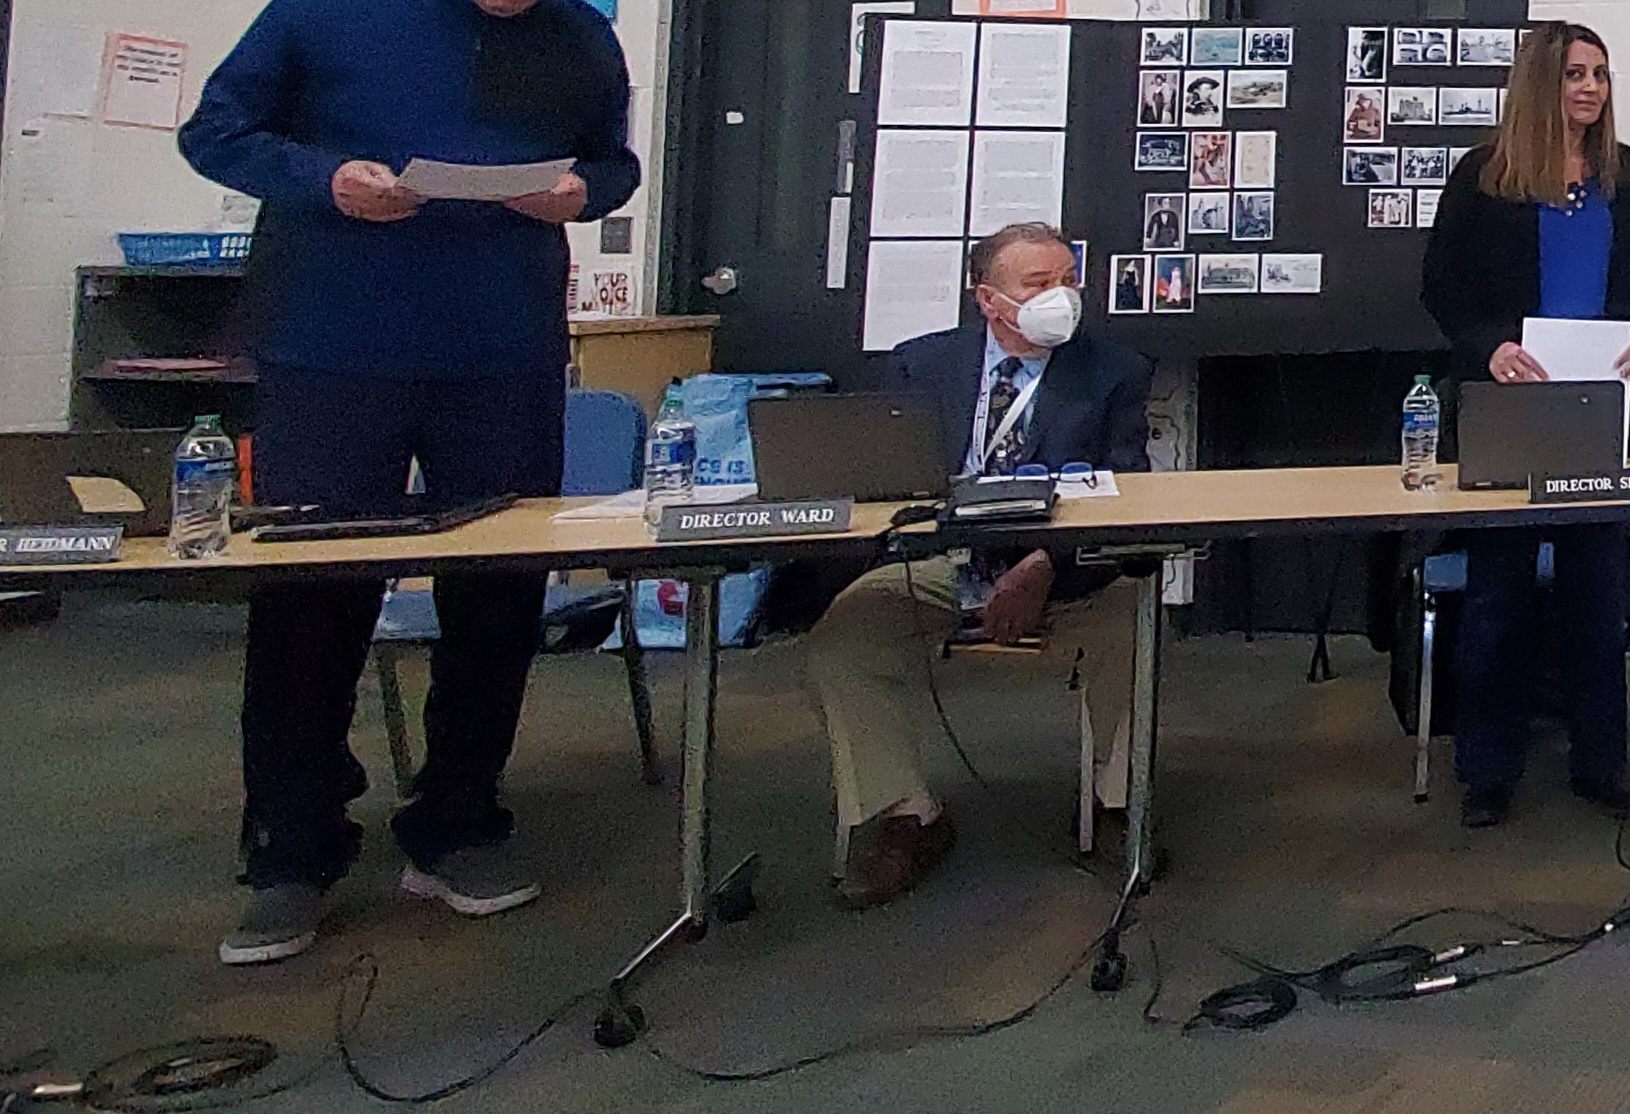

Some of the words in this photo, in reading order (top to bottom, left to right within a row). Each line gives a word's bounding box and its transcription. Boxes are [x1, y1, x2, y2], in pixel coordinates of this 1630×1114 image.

[1545, 477, 1615, 494] DIRECTOR
[680, 510, 771, 530] DIRECTOR
[781, 507, 835, 524] WARD
